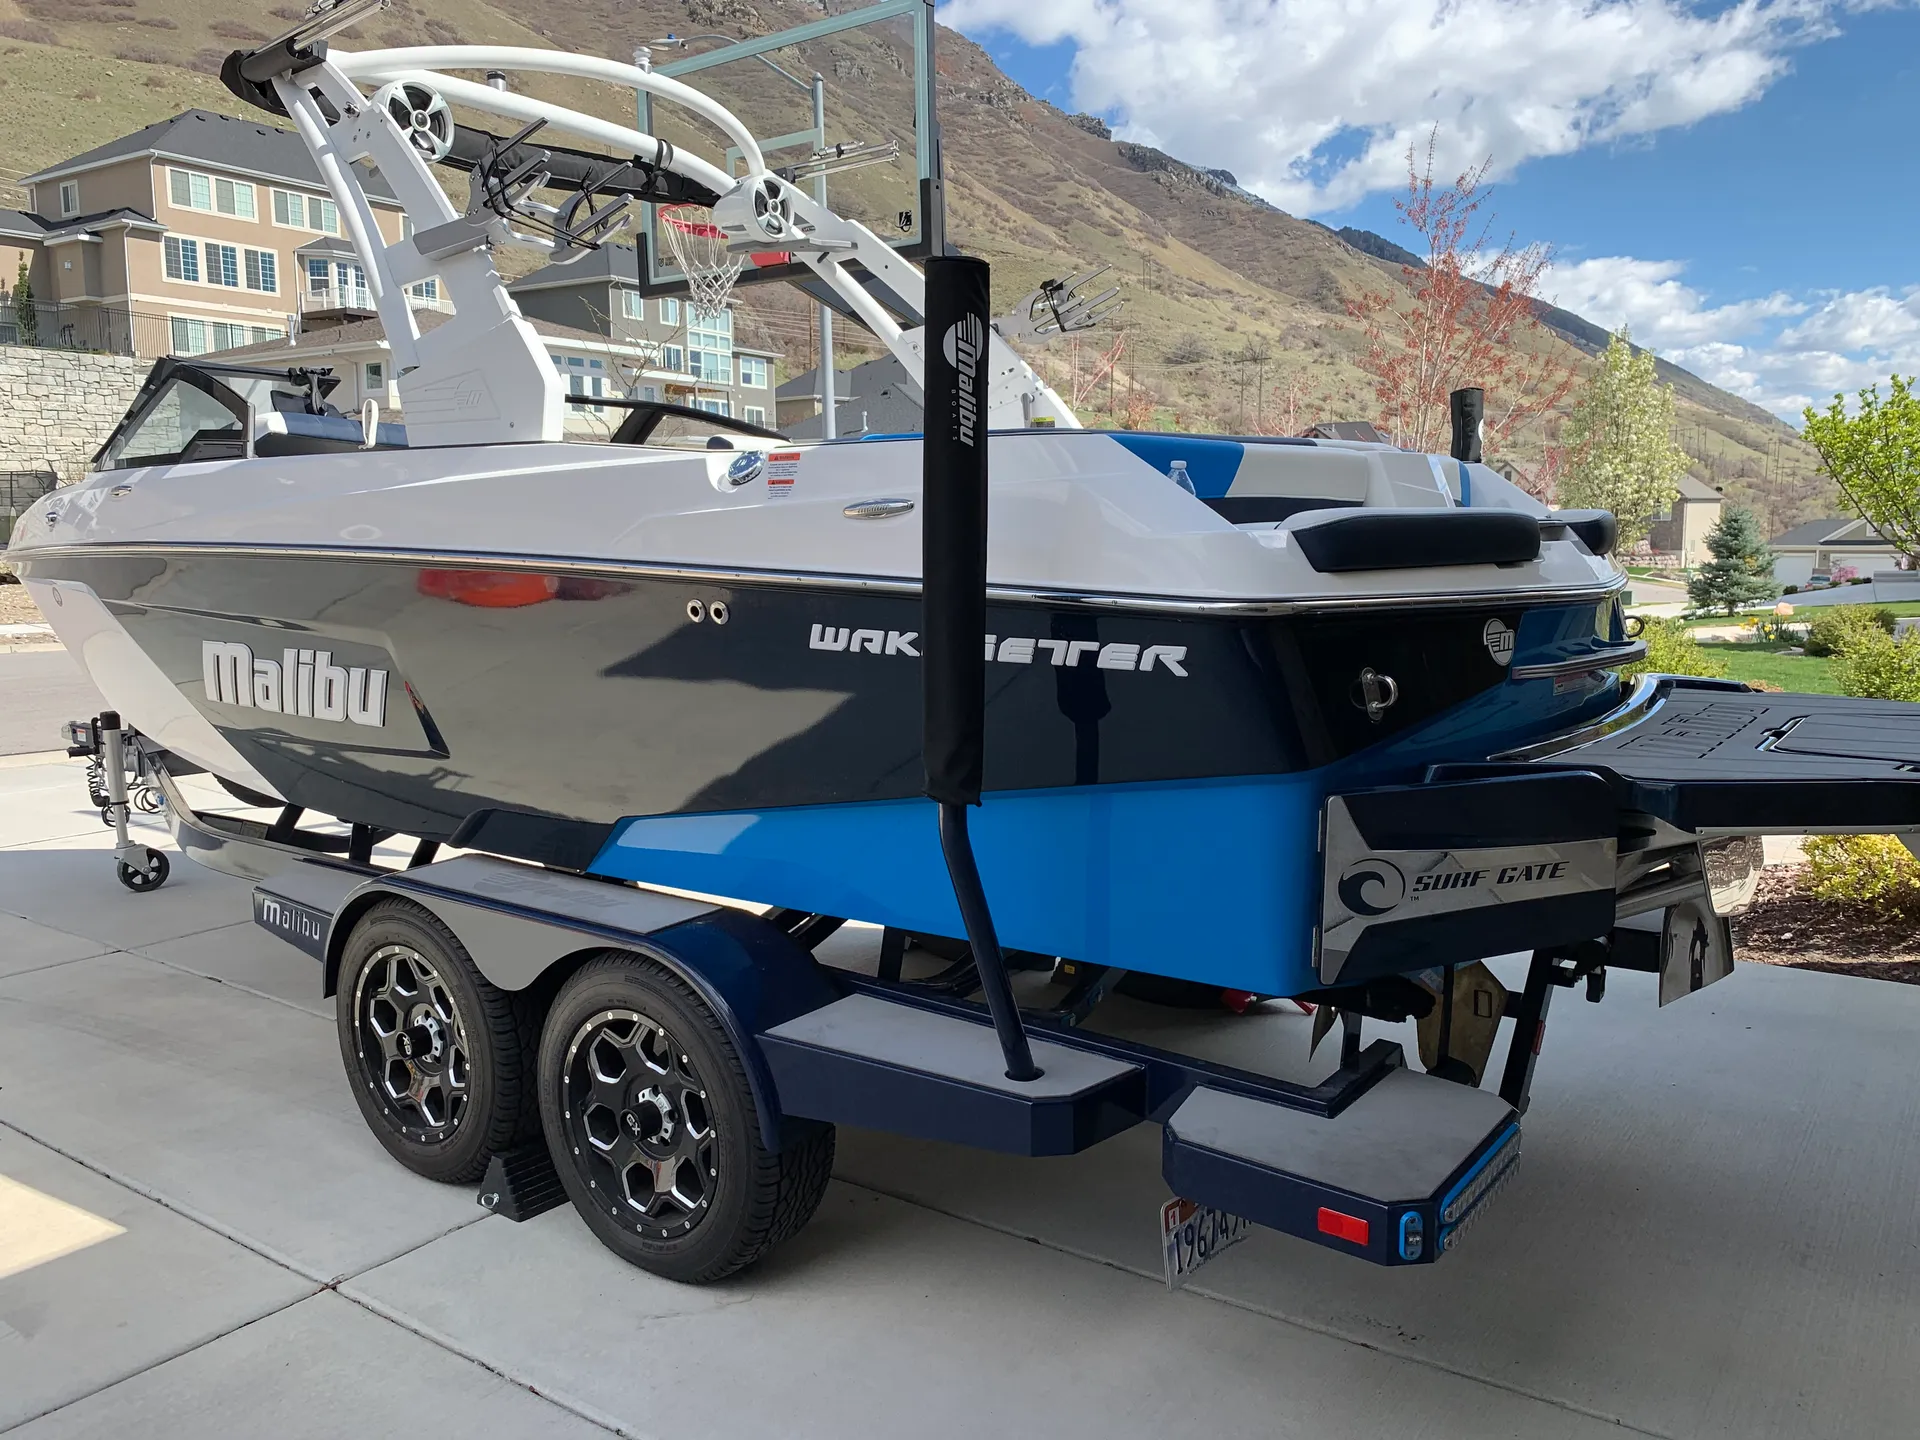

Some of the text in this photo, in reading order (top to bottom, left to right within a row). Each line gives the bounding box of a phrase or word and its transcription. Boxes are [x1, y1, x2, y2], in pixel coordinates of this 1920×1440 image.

[202, 640, 389, 727] Malibu
[1412, 861, 1570, 892] SURF GATE
